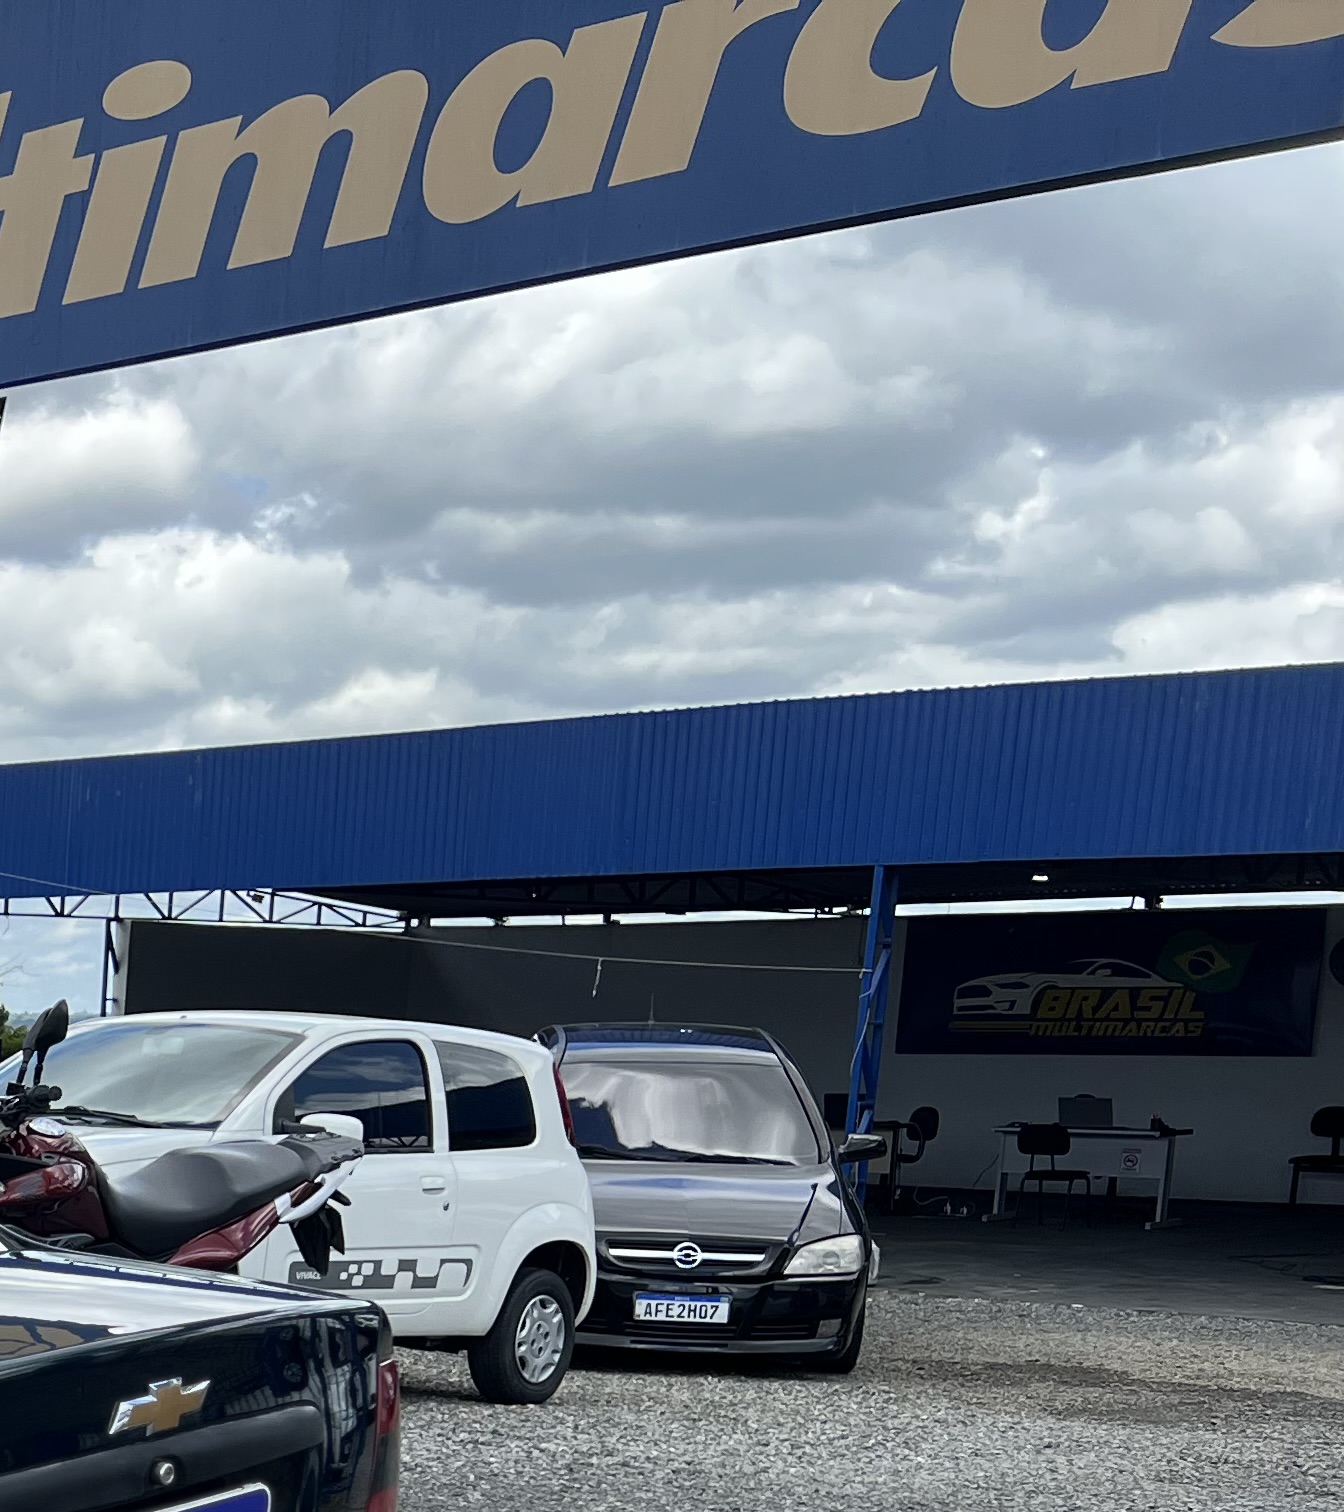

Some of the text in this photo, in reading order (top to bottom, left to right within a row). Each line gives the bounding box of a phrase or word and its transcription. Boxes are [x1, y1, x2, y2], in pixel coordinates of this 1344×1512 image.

[1036, 988, 1205, 1019] BRASIL
[1029, 1021, 1205, 1037] MULTIMARCAS
[643, 1302, 720, 1320] AFE2H07
